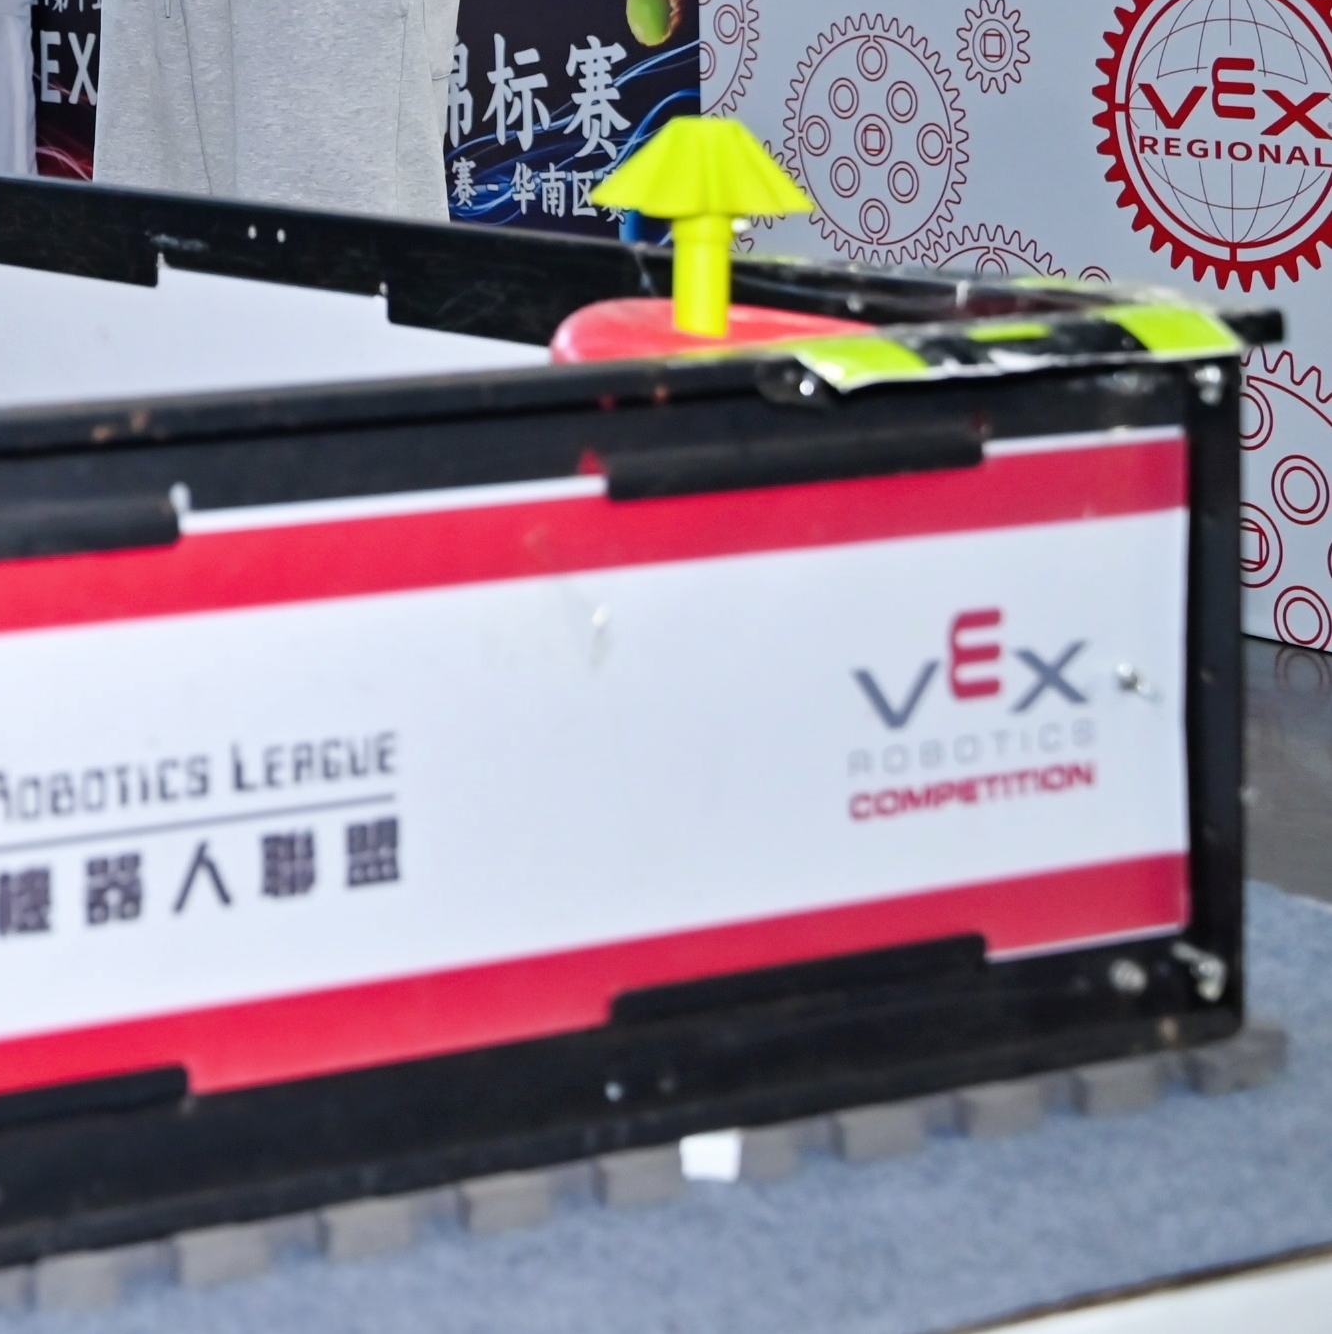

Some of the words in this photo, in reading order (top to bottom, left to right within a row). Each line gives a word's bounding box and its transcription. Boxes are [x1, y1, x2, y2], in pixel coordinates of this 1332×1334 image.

[1137, 56, 1332, 141] VEX
[1138, 135, 1332, 168] REGIONAL
[851, 607, 1091, 730] VEX
[847, 761, 1098, 822] COMPETITION
